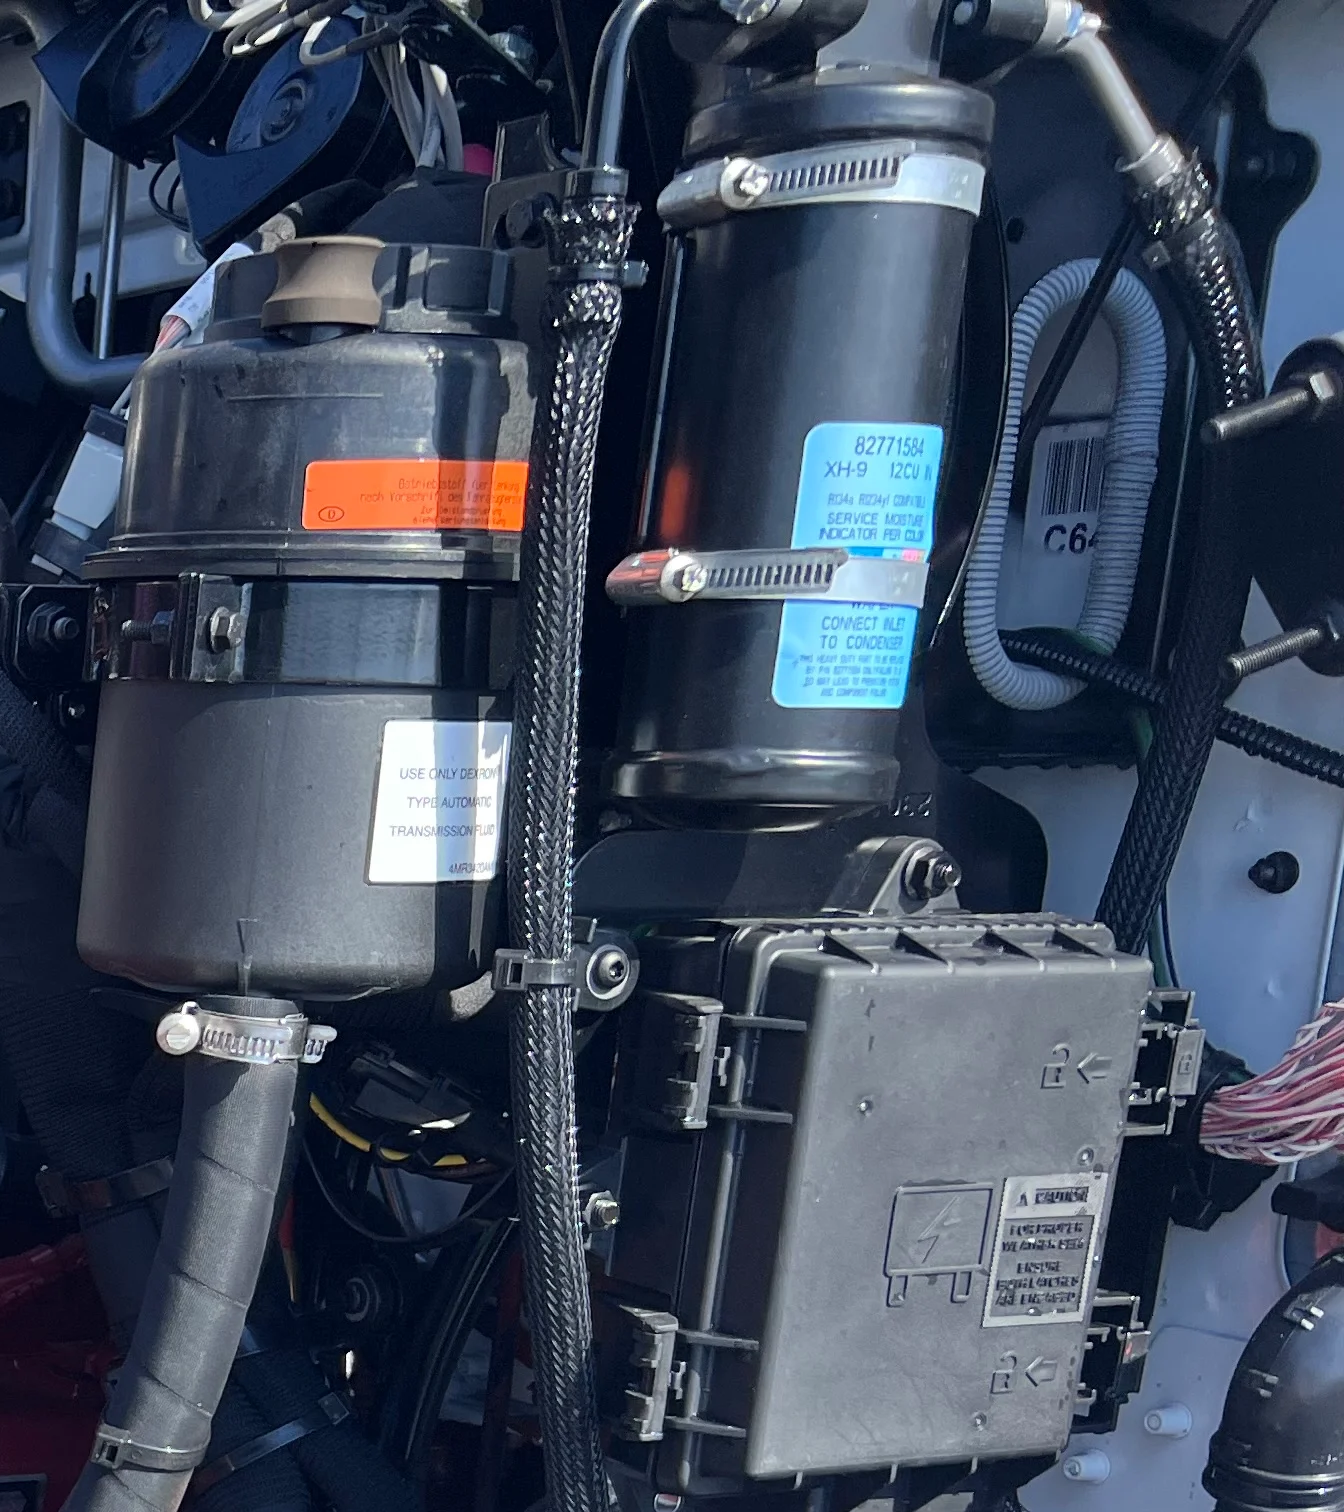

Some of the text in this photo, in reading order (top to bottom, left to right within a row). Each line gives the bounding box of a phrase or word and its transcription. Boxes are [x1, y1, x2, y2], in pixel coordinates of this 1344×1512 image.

[854, 435, 925, 457] 82771584
[824, 461, 868, 478] XH-9
[827, 512, 879, 525] SERVICE
[819, 528, 877, 541] INDICATOR
[883, 529, 901, 541] PER
[821, 616, 879, 631] CONNECT
[820, 635, 904, 650] TO CONDENSER
[399, 768, 425, 780] USE
[429, 768, 458, 779] ONLY
[407, 796, 492, 809] TYPE AUTOMATIC
[390, 824, 495, 837] TRANSMISSION FLUID
